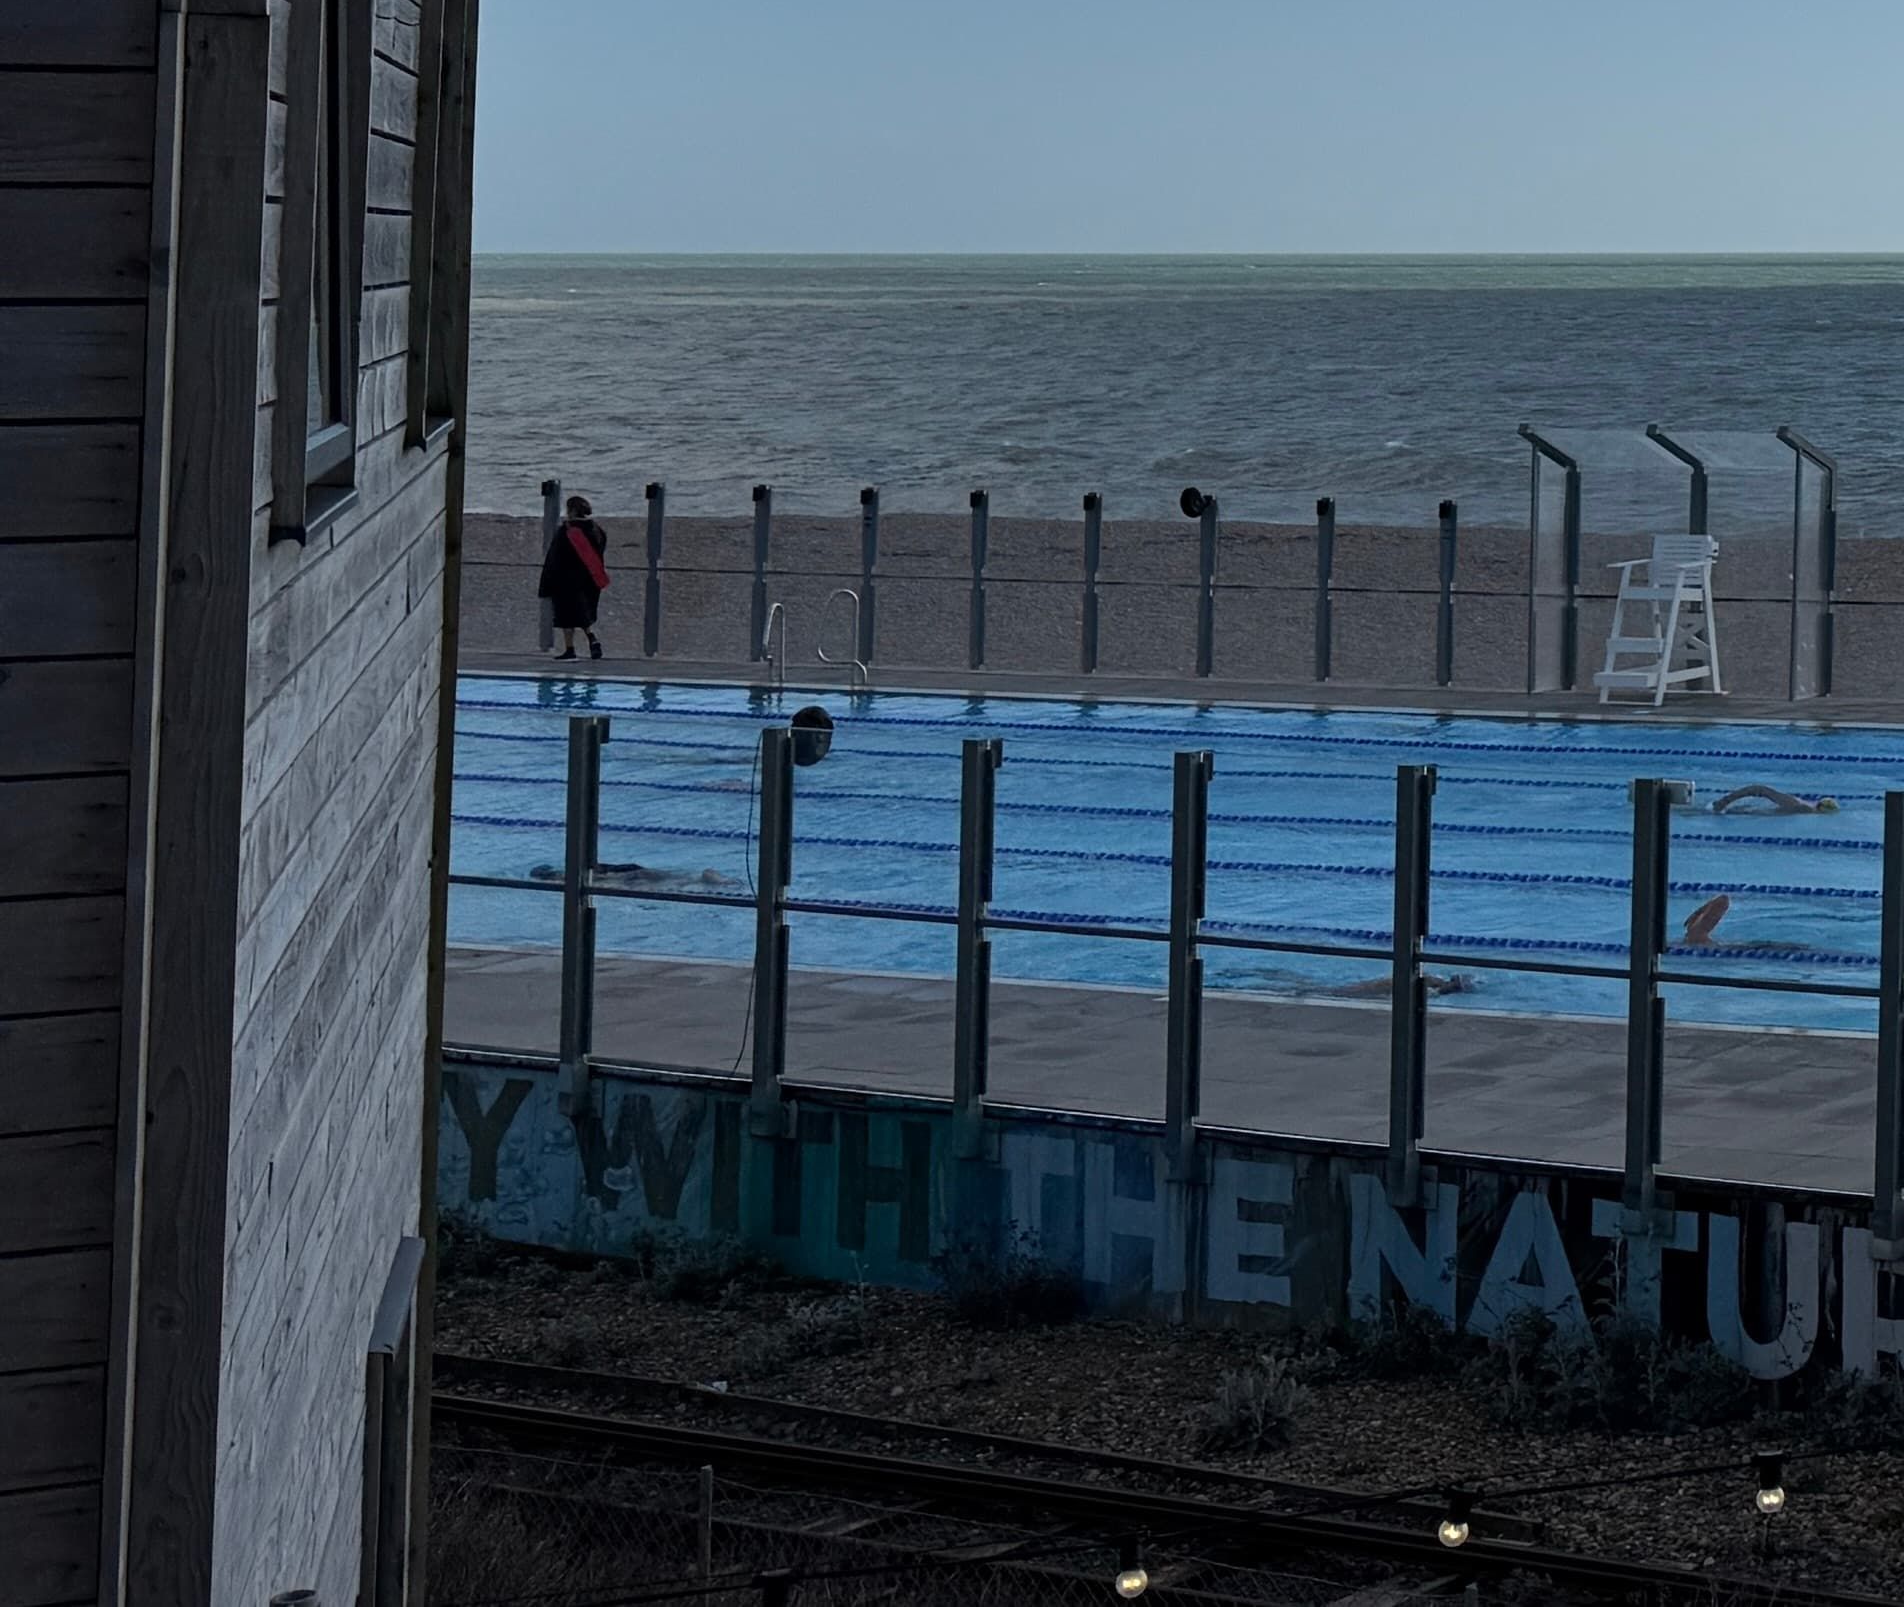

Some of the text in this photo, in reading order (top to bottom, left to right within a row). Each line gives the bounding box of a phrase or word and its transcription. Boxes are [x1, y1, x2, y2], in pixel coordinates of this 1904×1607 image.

[441, 1072, 533, 1201] Y
[572, 1090, 931, 1261] WITH
[999, 1132, 1295, 1308] THE
